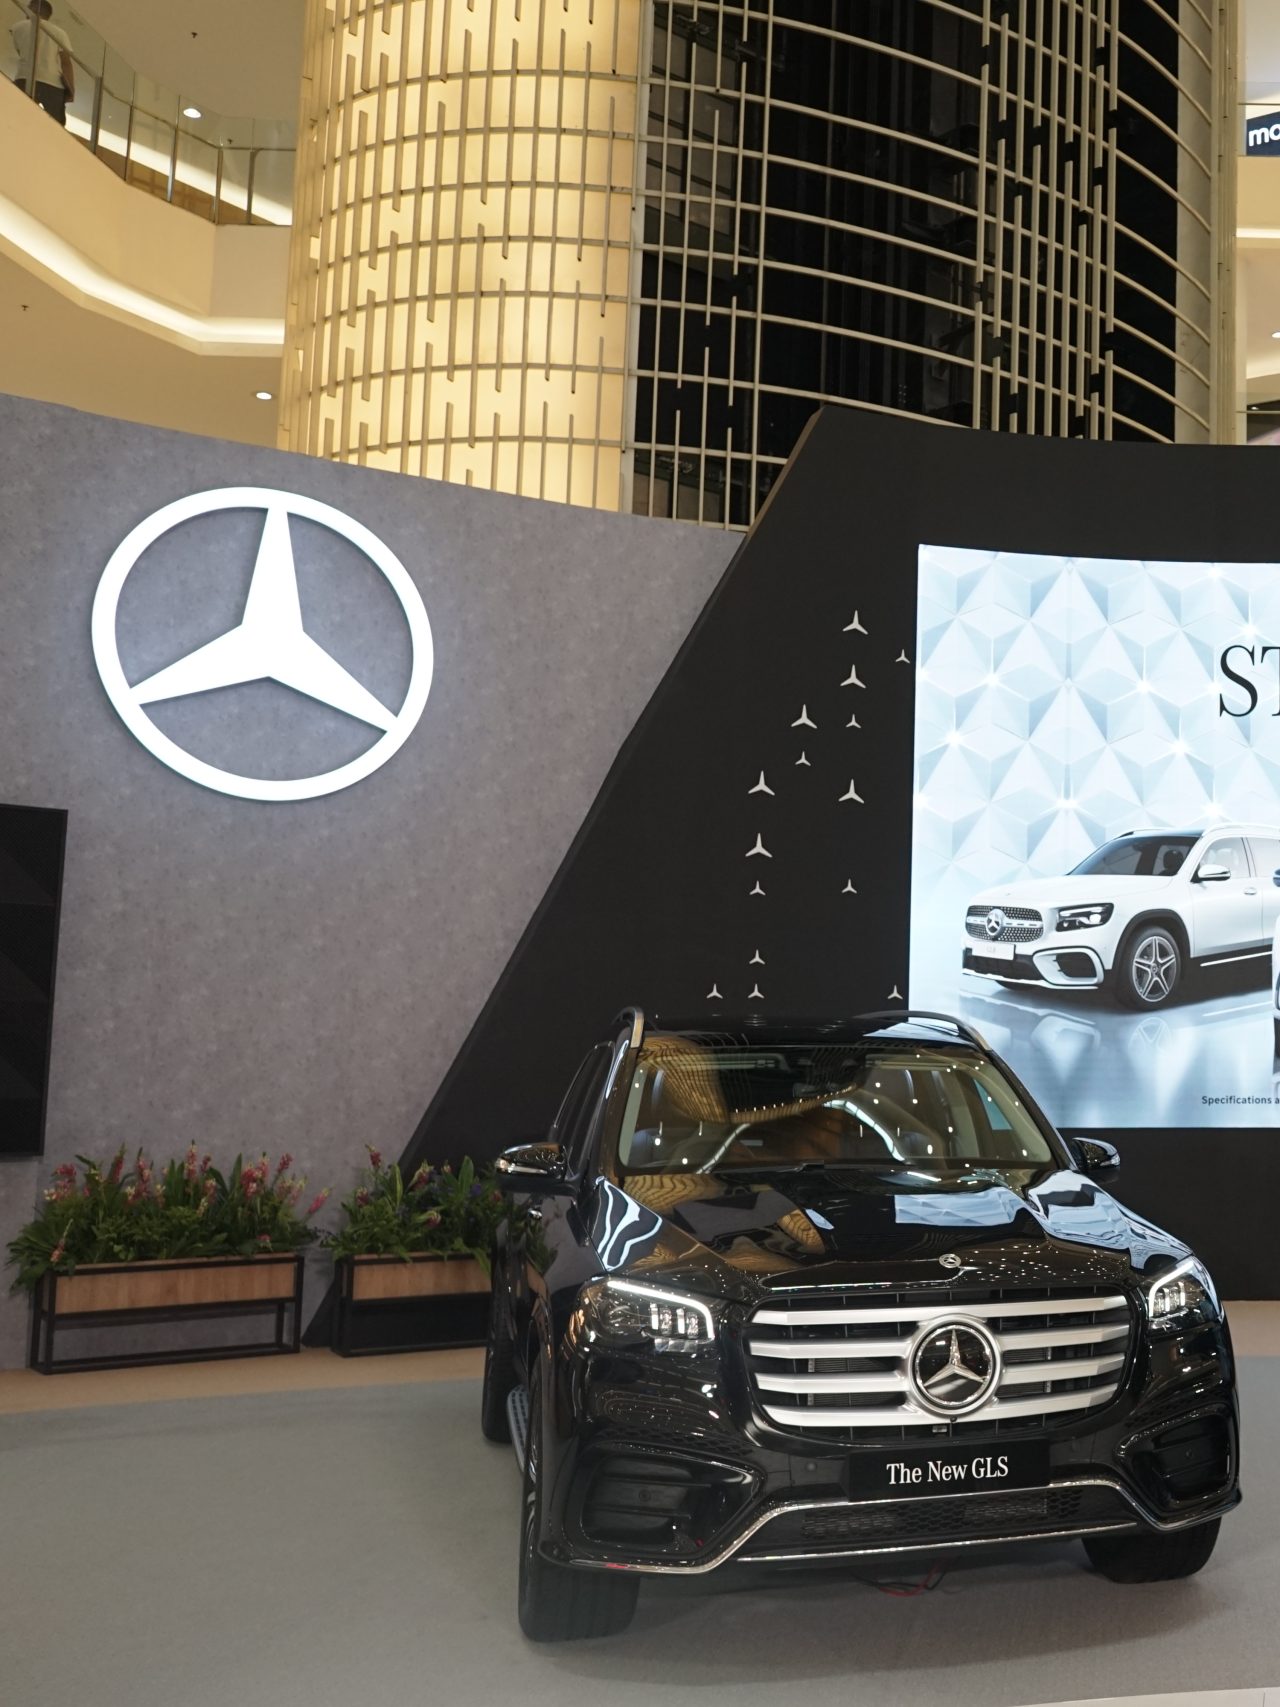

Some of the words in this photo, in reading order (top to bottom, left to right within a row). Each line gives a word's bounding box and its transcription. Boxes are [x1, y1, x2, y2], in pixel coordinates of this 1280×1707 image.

[1201, 1095, 1272, 1107] Specifications
[886, 1463, 922, 1485] The
[927, 1460, 968, 1482] New
[971, 1456, 1009, 1479] GLS
